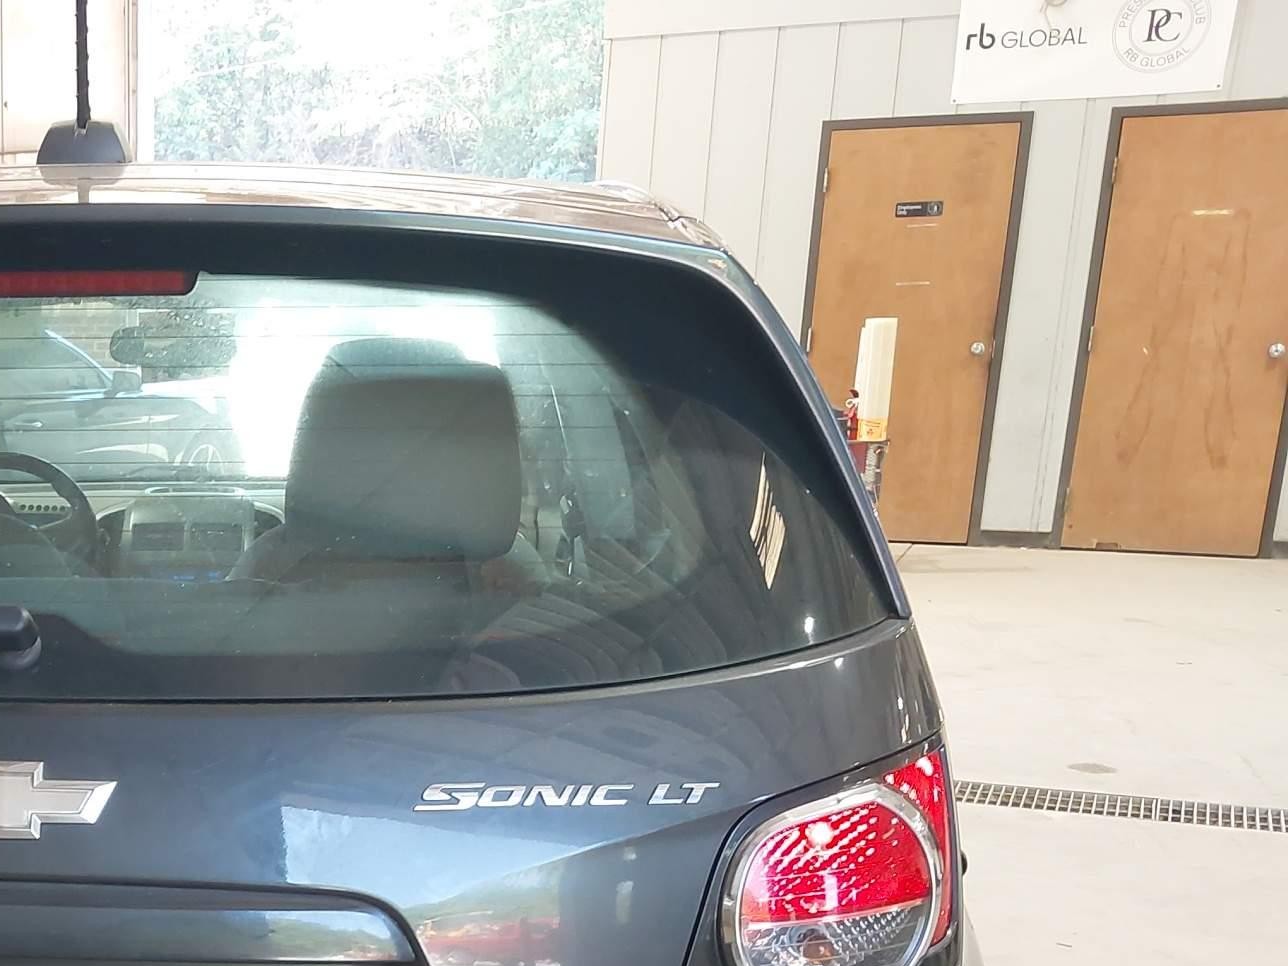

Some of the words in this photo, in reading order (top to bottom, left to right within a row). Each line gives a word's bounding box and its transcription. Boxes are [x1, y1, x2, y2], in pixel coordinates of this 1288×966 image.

[1118, 0, 1144, 28] PRES
[1142, 8, 1183, 43] PC
[965, 22, 996, 51] rb
[1001, 26, 1088, 49] GLOBAL
[1123, 47, 1139, 63] RB
[1139, 47, 1191, 68] GLOBAL
[647, 782, 721, 805] LT
